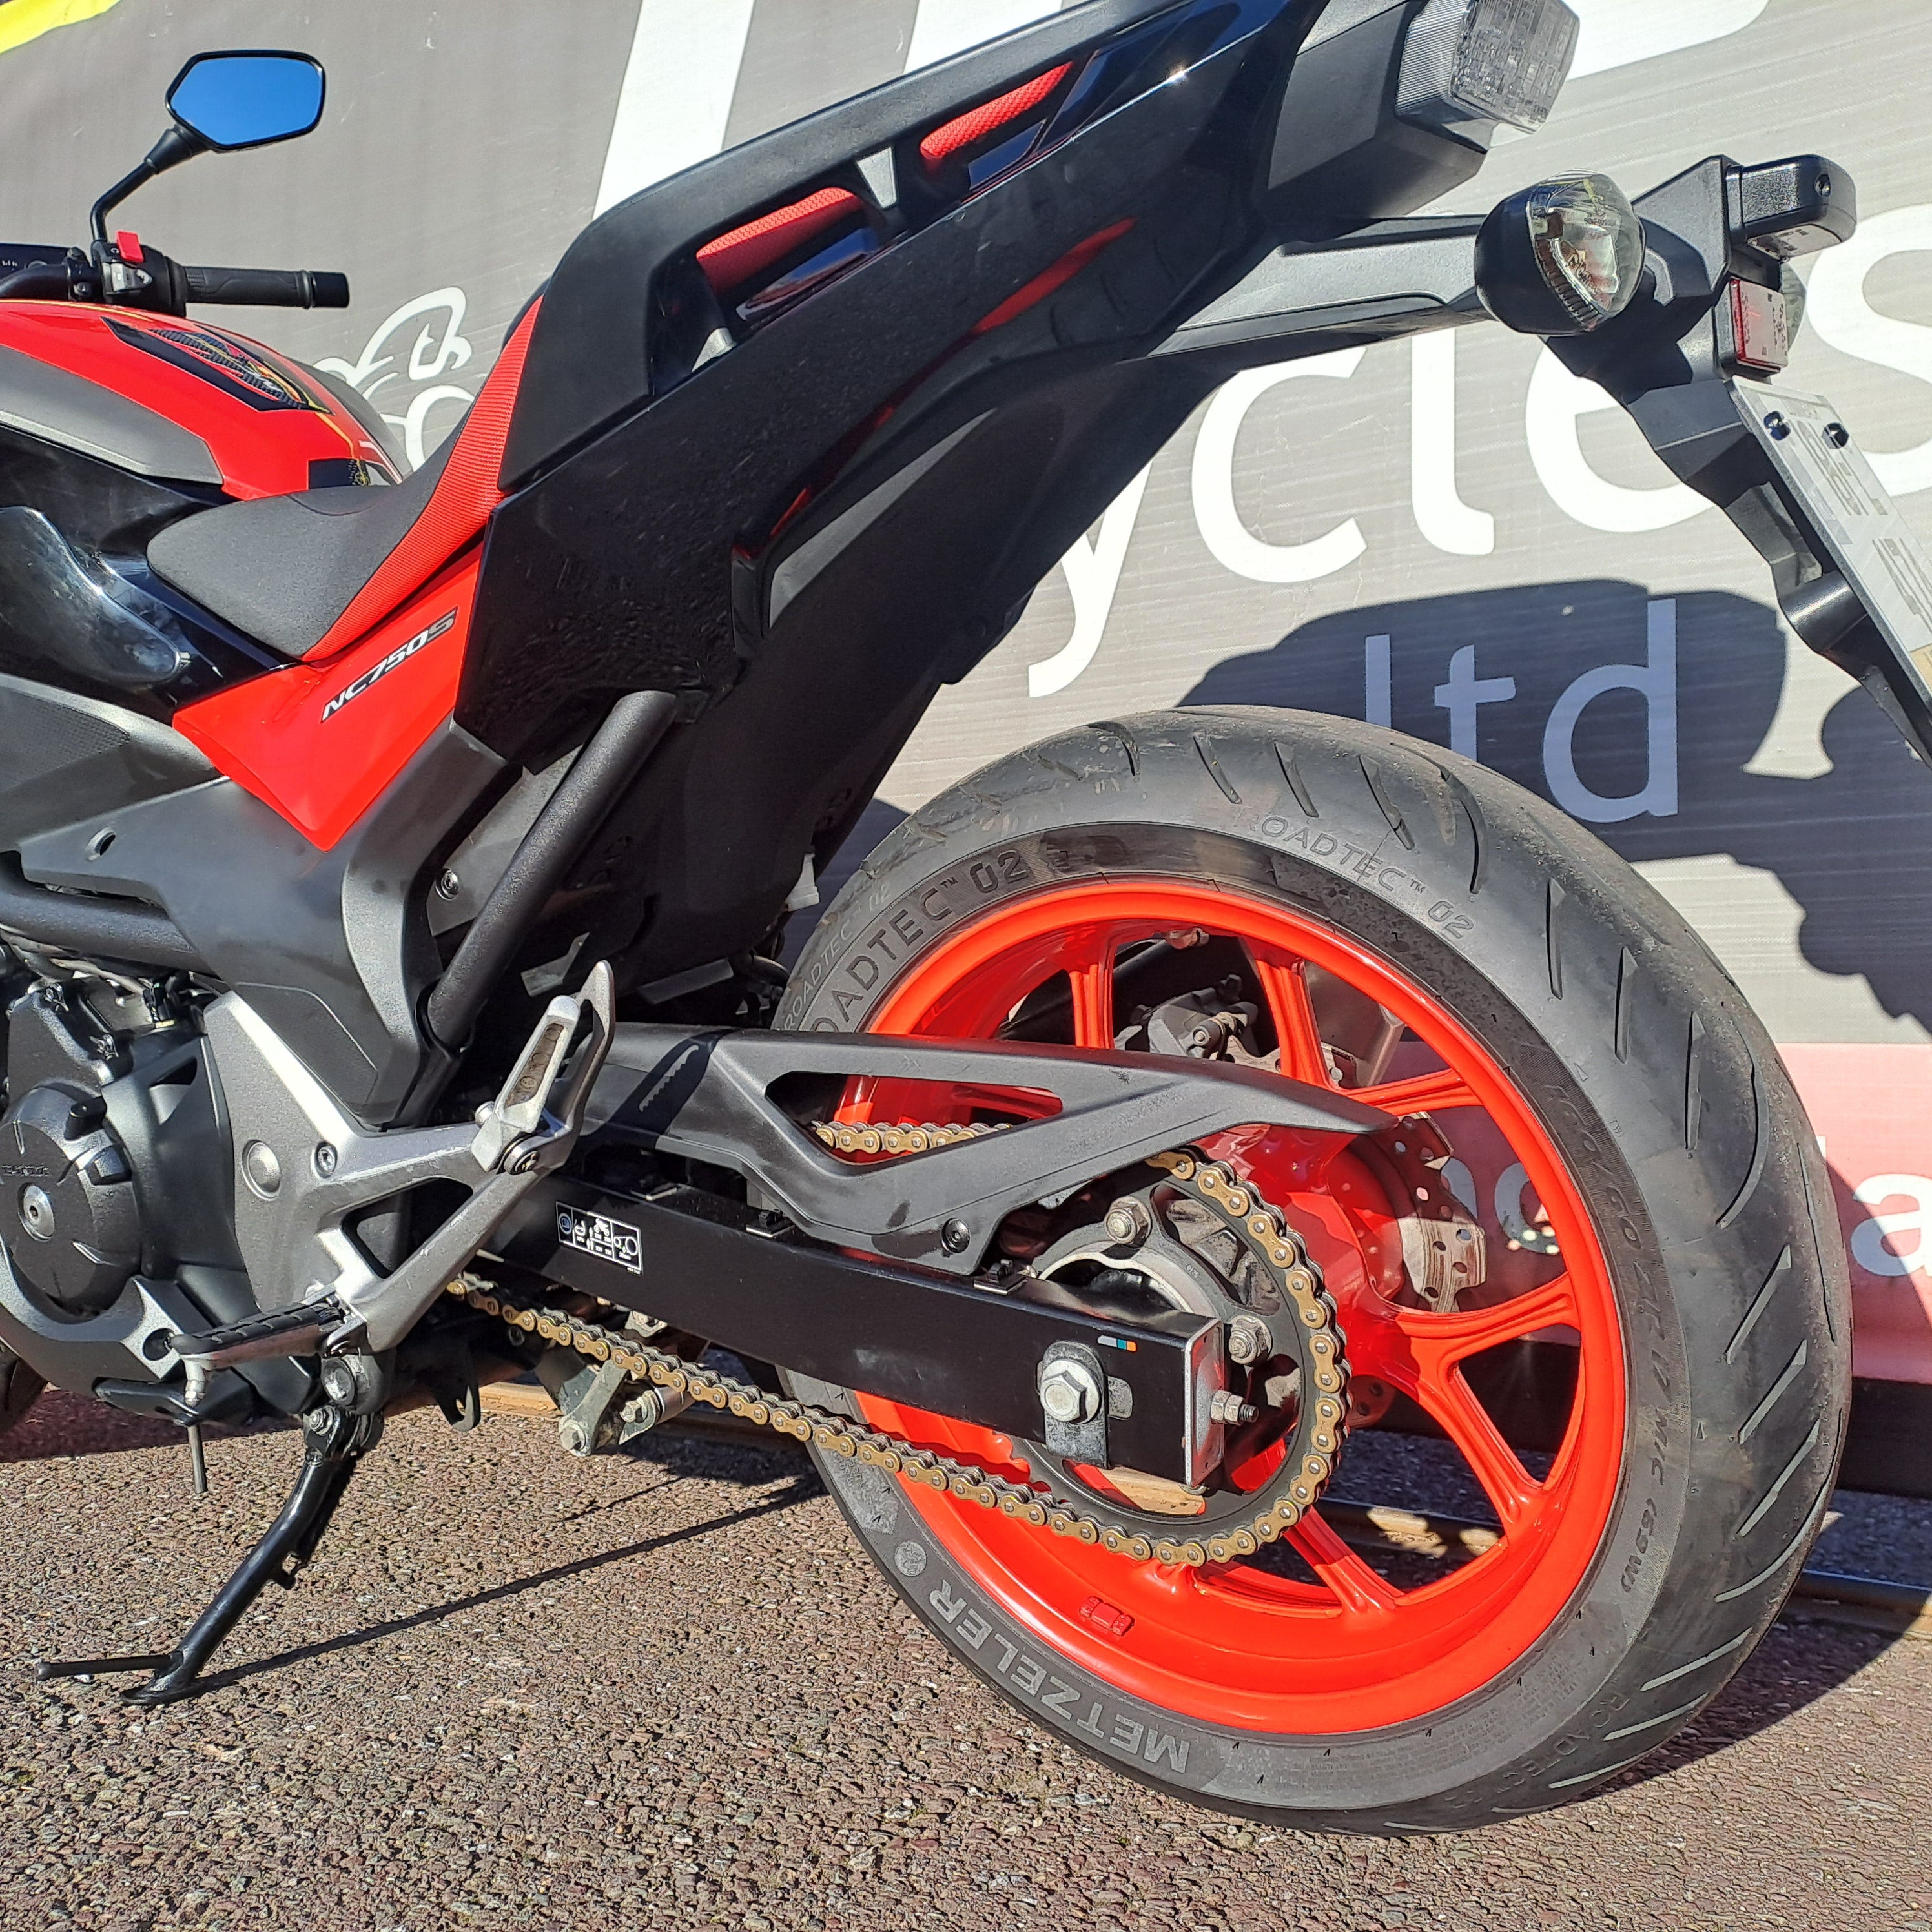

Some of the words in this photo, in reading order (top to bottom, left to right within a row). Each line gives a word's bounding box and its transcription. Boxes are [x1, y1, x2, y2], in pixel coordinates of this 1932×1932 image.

[322, 608, 457, 722] NC750S
[1364, 598, 1678, 823] ltd
[969, 850, 1029, 894] 02
[1428, 900, 1474, 939] 02
[929, 1579, 1191, 1774] METZELER
